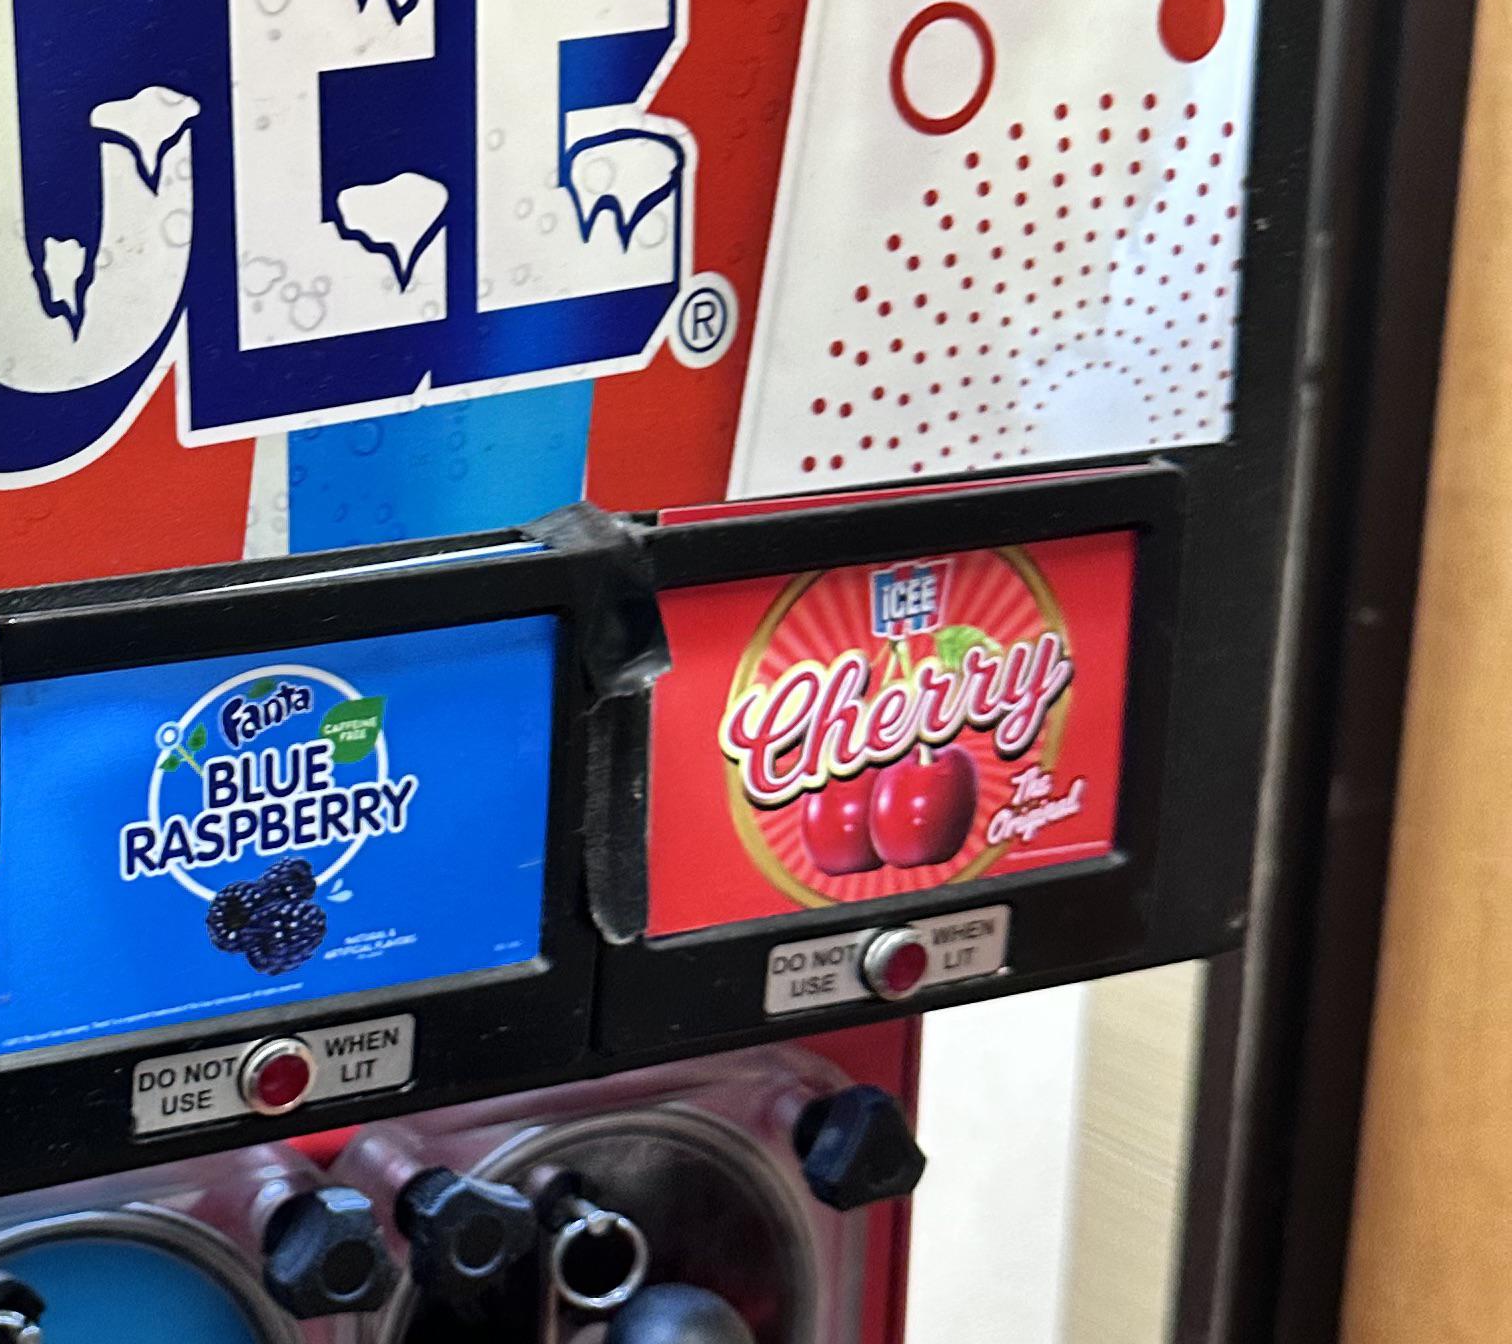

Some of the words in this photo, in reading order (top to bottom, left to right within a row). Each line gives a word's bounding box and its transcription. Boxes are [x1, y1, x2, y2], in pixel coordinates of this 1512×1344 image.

[882, 575, 938, 622] ICEE
[220, 682, 313, 749] Fanta
[722, 632, 1071, 806] Cherry
[206, 742, 335, 810] BLUE
[1011, 765, 1053, 805] The
[123, 780, 416, 877] RASPBERRY
[933, 919, 995, 945] WHEN
[772, 953, 806, 975] DO
[812, 943, 858, 968] NOT
[944, 947, 974, 969] LIT
[791, 973, 837, 997] USE
[325, 1027, 399, 1057] WHEN
[138, 1068, 176, 1092] DO
[184, 1057, 237, 1083] NOT
[341, 1059, 376, 1083] LIT
[161, 1089, 212, 1116] USE
